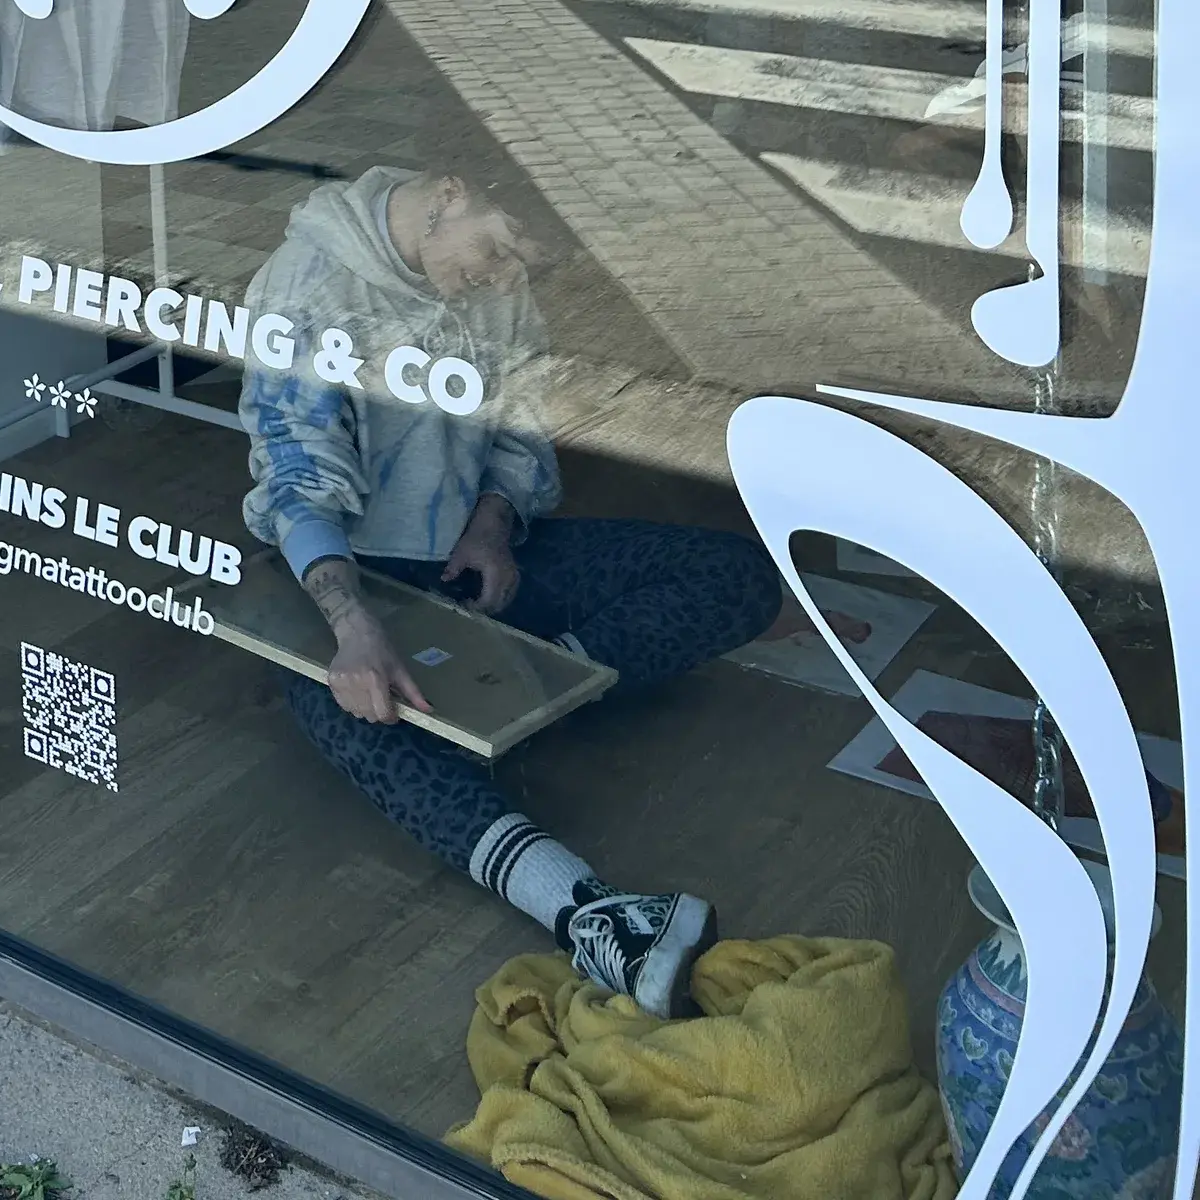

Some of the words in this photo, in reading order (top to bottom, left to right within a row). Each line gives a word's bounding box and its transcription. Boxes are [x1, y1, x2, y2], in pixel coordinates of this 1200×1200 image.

[19, 255, 295, 370] PIERCING
[313, 327, 363, 389] &
[384, 345, 484, 416] CO
[74, 497, 121, 549] LE
[127, 516, 243, 586] CLUB
